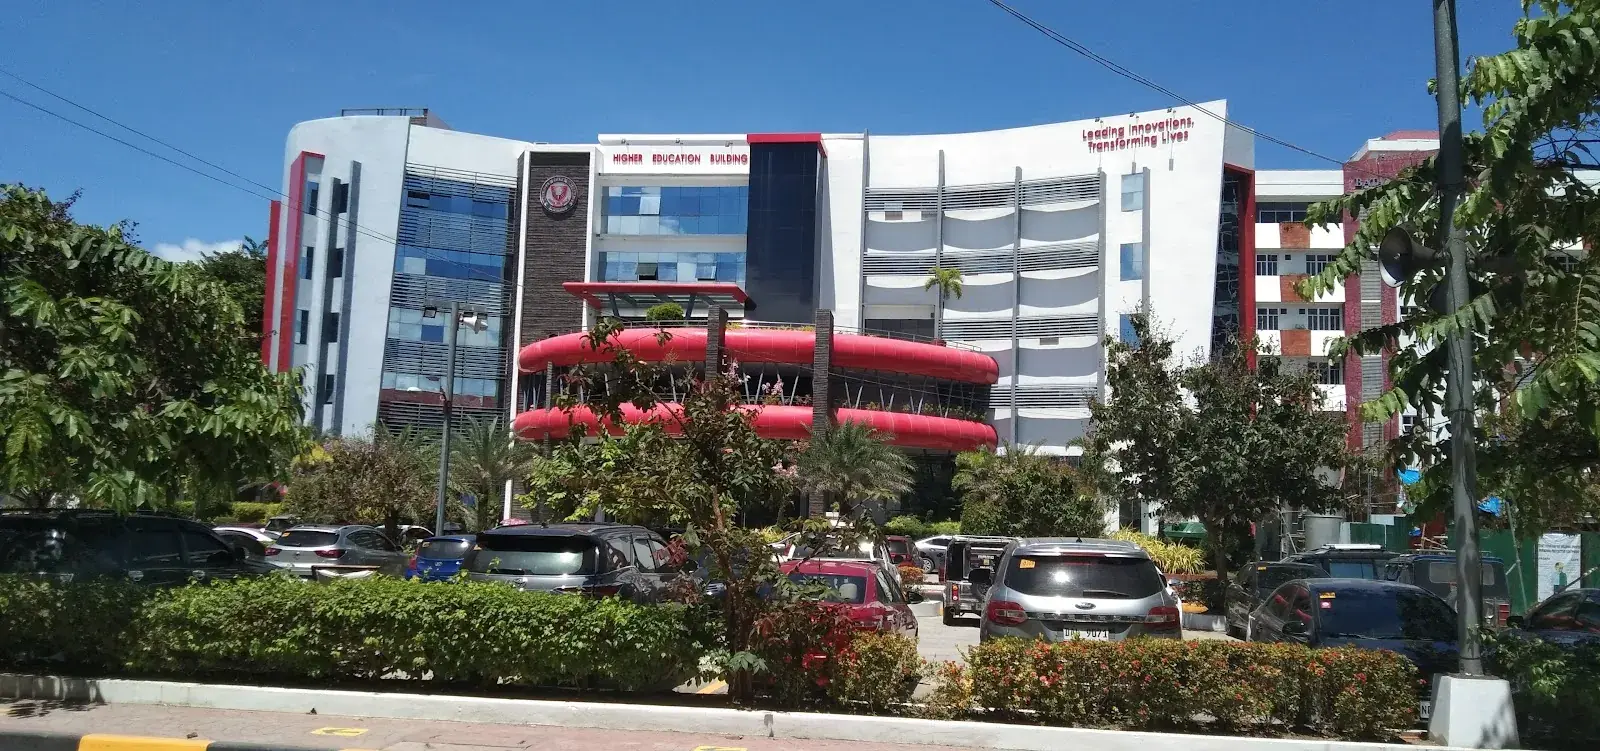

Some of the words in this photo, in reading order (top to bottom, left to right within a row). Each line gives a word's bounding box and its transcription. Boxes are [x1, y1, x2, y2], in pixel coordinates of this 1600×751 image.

[1082, 126, 1124, 140] Leading
[1129, 117, 1194, 134] Innovations,
[1088, 135, 1157, 150] Transforming
[1162, 131, 1188, 142] Lives
[612, 153, 643, 164] HIGHER
[652, 153, 701, 164] EDUCATION
[710, 153, 748, 164] BUILDING
[1086, 628, 1107, 638] 9071
